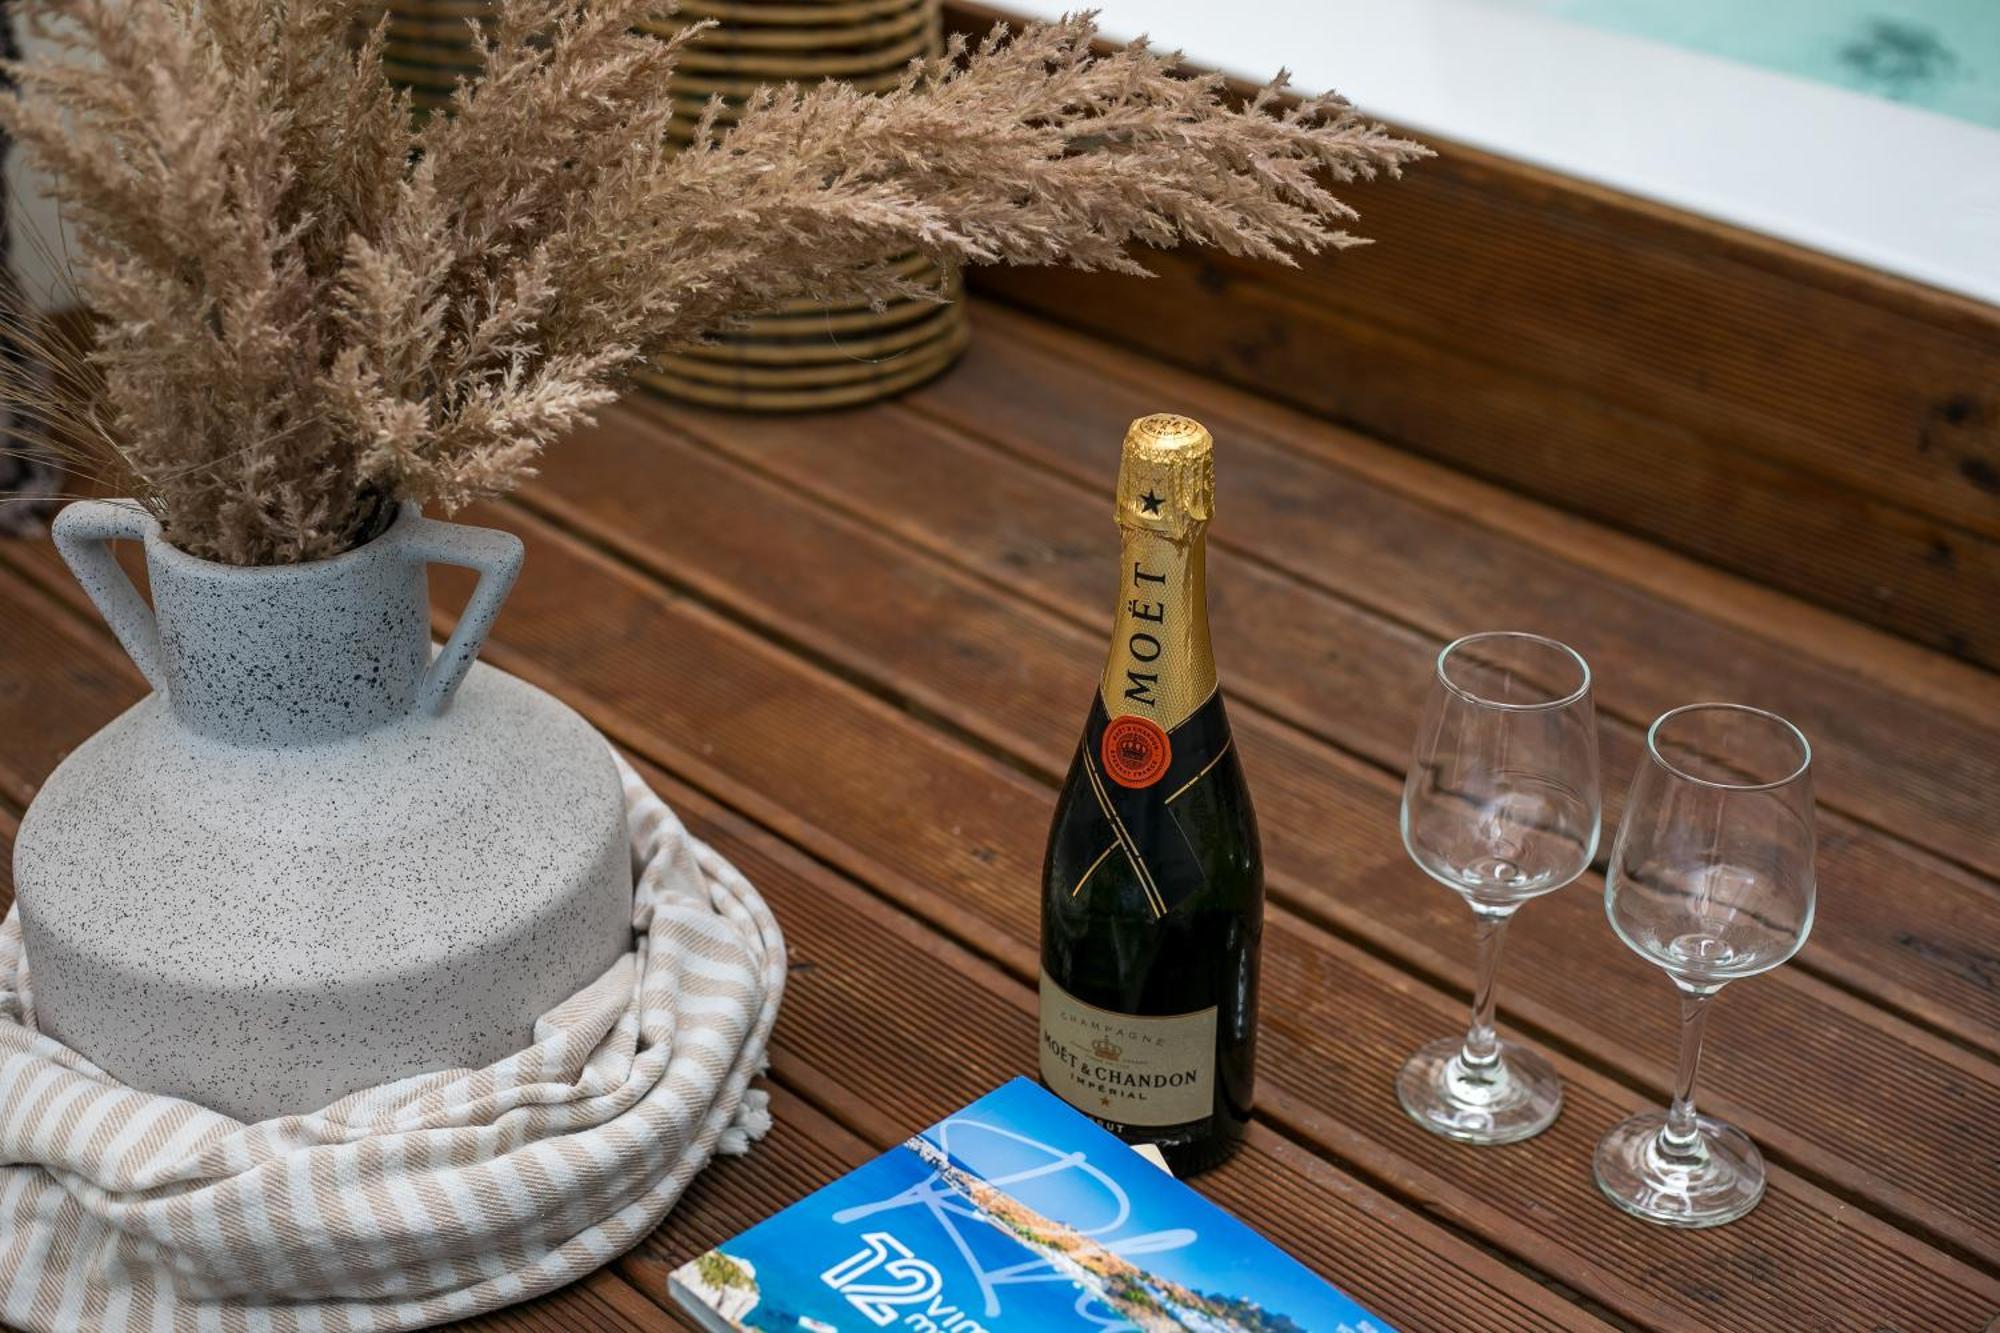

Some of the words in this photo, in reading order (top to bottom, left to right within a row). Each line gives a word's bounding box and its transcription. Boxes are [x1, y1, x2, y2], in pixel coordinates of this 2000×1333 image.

[1124, 561, 1166, 707] MOËT
[1060, 1011, 1166, 1047] CHAMPAGNE
[1080, 1062, 1091, 1076] &
[1095, 1066, 1198, 1089] CHANDON
[820, 1231, 943, 1327] 12
